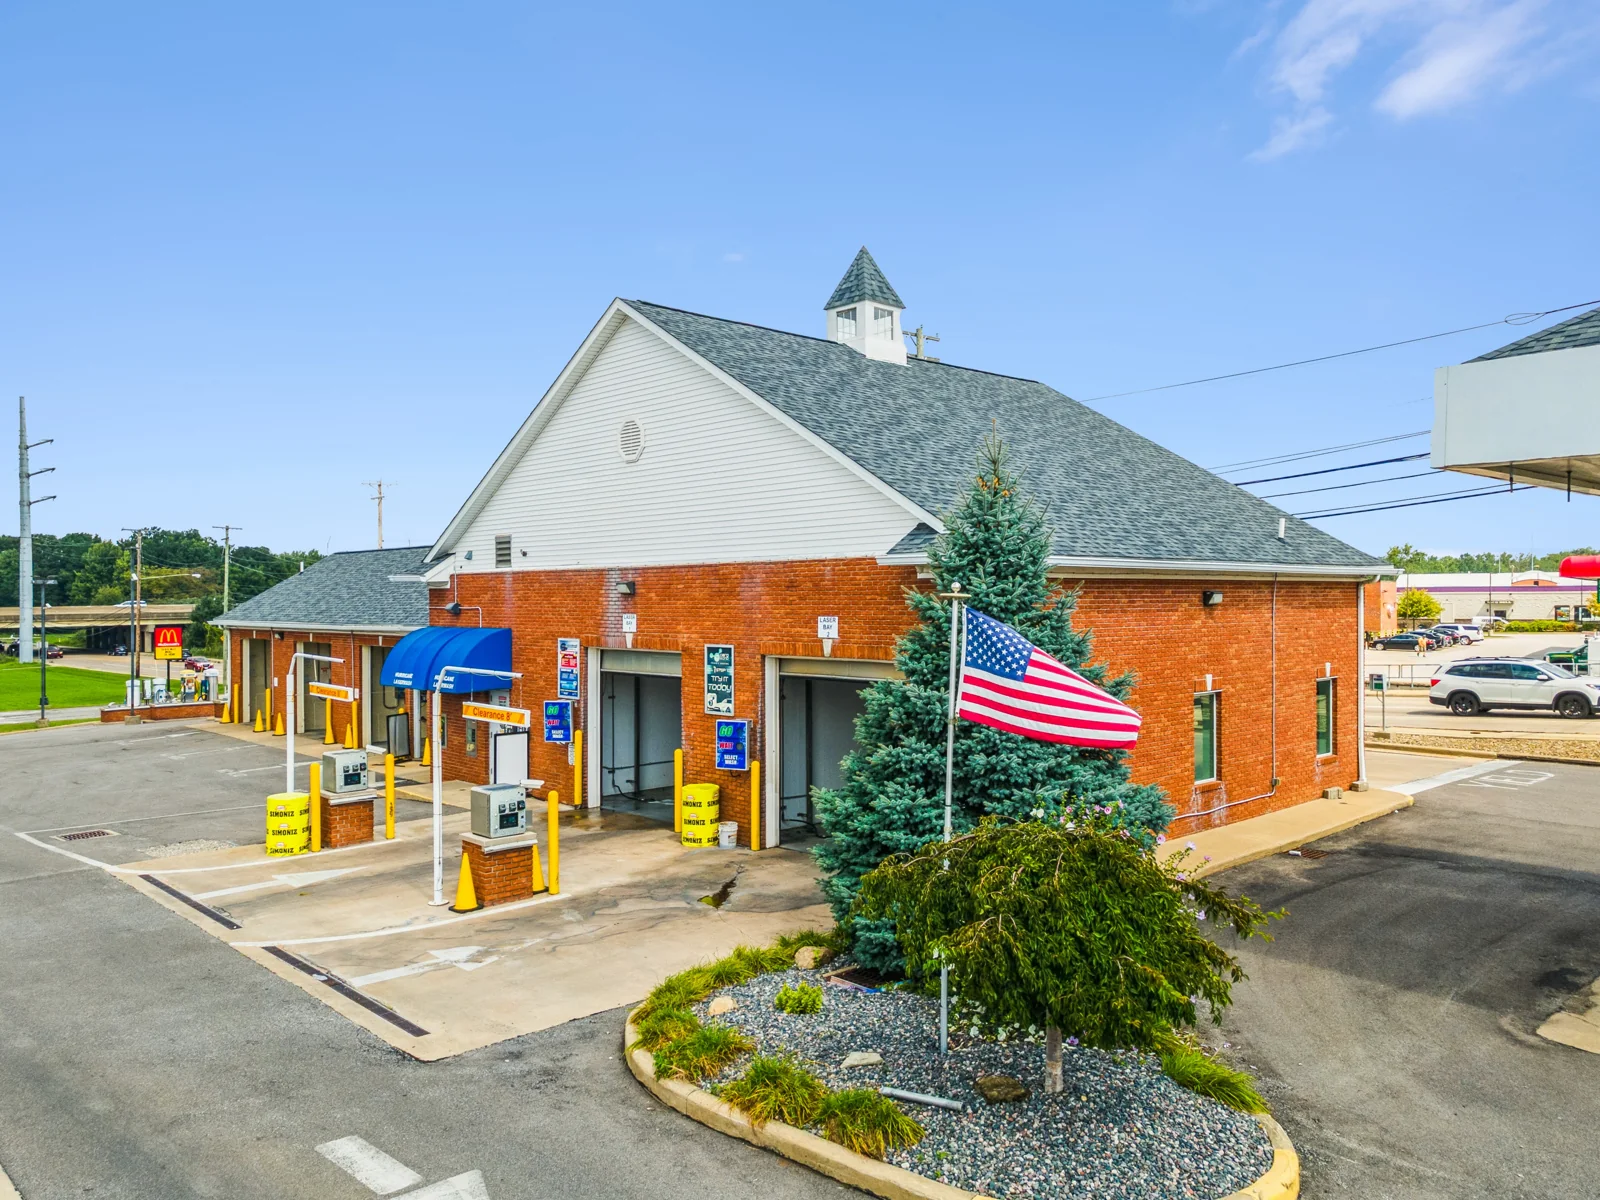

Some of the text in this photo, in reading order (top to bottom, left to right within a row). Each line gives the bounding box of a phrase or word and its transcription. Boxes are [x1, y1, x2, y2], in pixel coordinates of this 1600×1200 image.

[472, 707, 504, 720] Clearance
[547, 705, 559, 715] GO
[719, 725, 733, 737] GO
